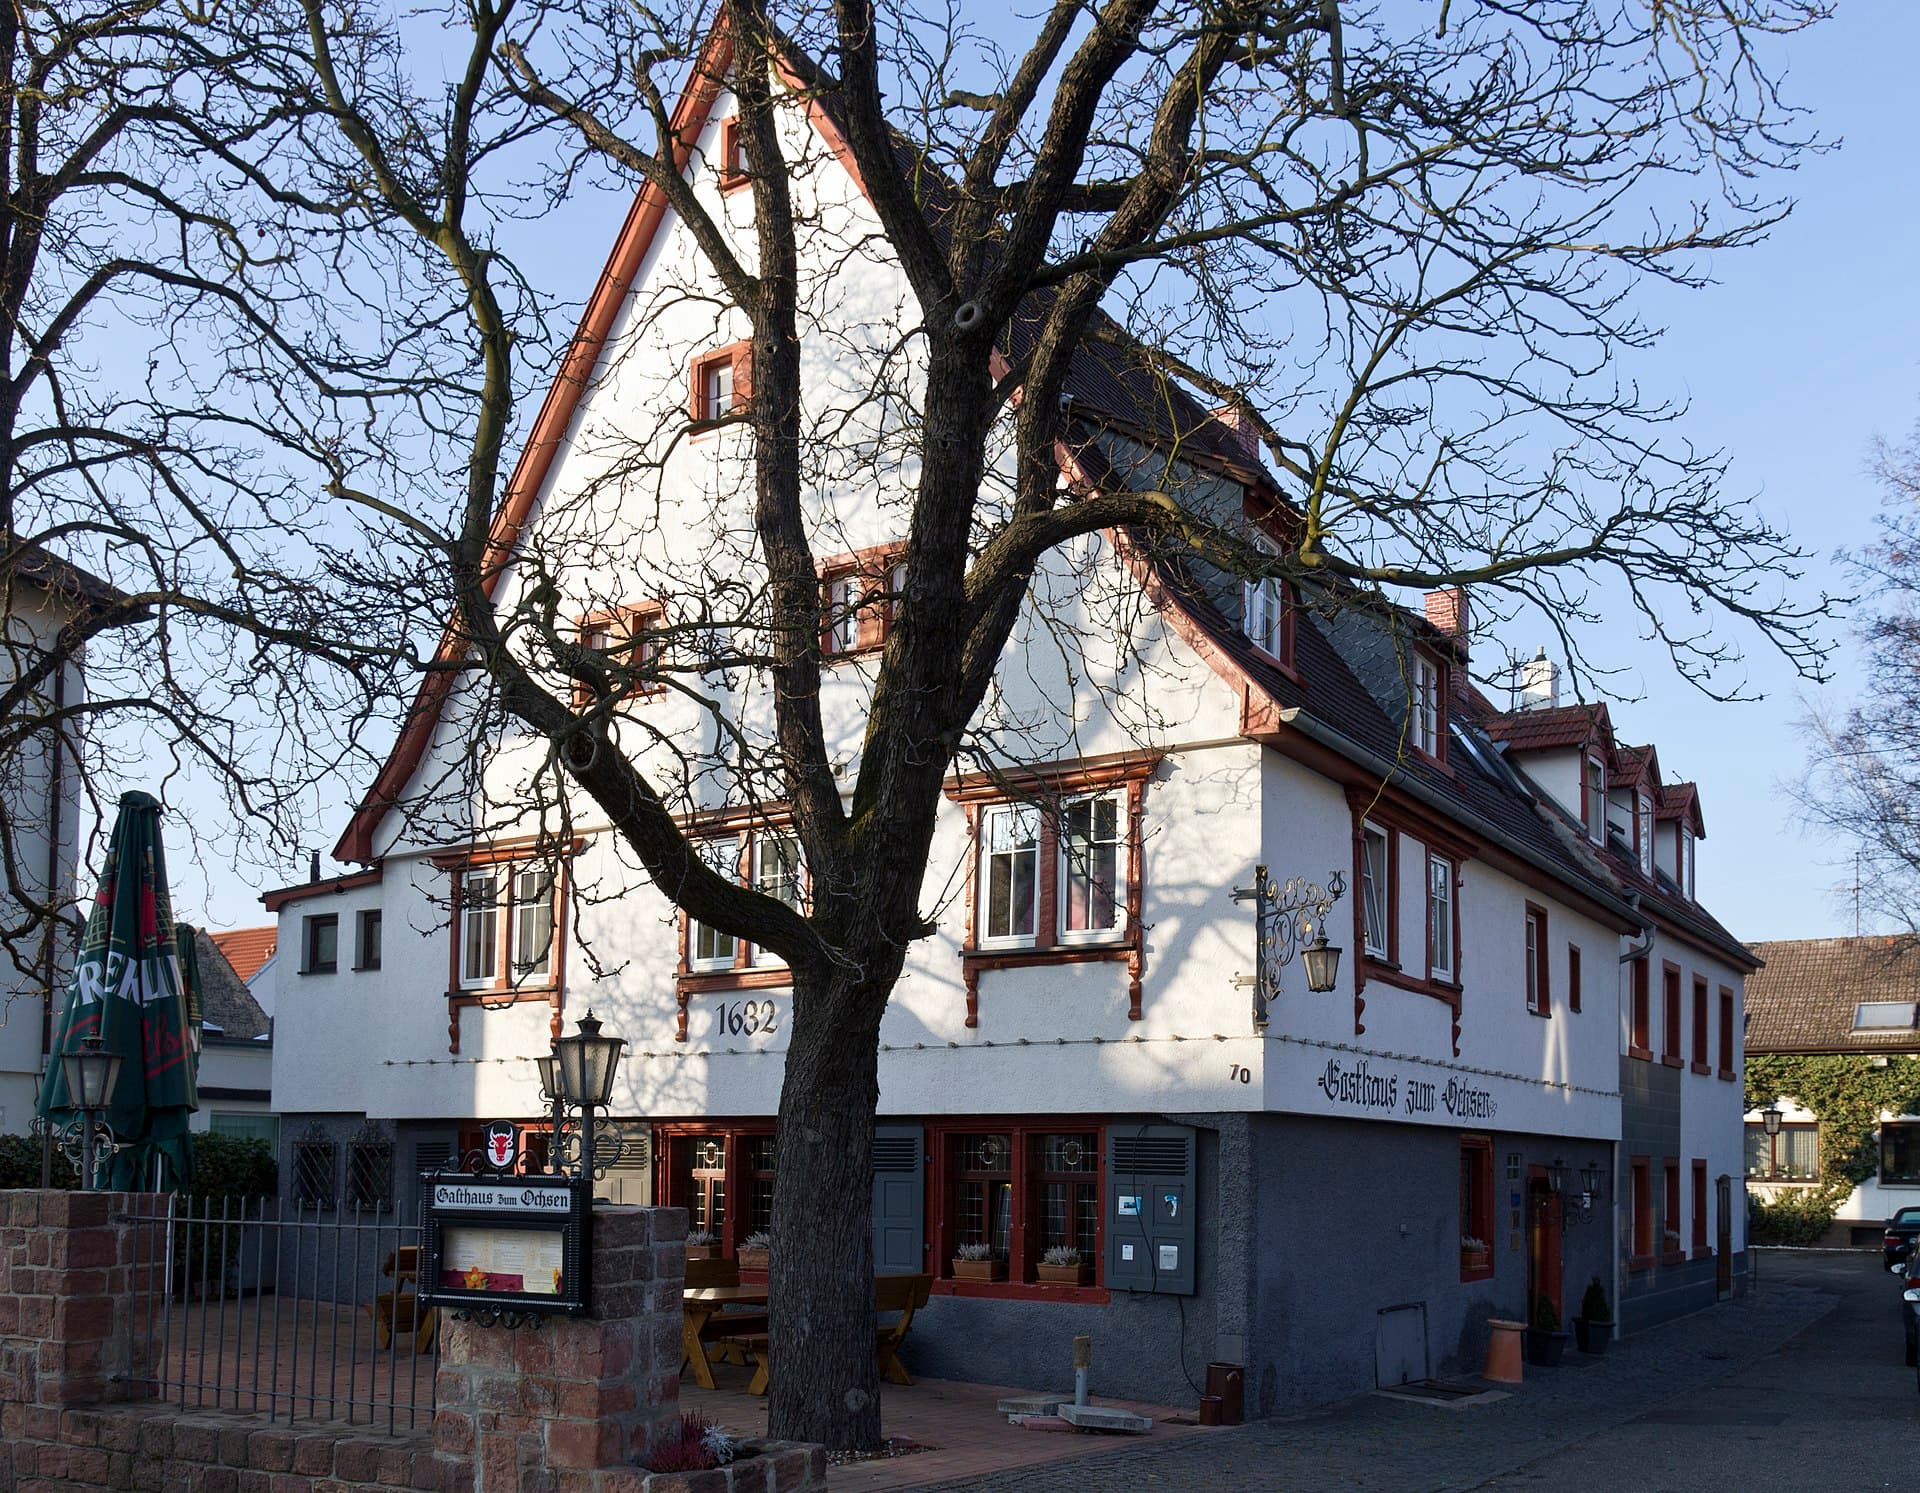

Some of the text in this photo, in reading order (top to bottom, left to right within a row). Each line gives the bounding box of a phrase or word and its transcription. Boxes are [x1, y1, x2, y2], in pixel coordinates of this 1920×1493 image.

[715, 1000, 778, 1036] 1632
[1229, 1064, 1250, 1084] 70
[1318, 1058, 1398, 1114] Gasthaus
[1441, 1076, 1494, 1123] Ochsen
[520, 1189, 569, 1209] Ochsen
